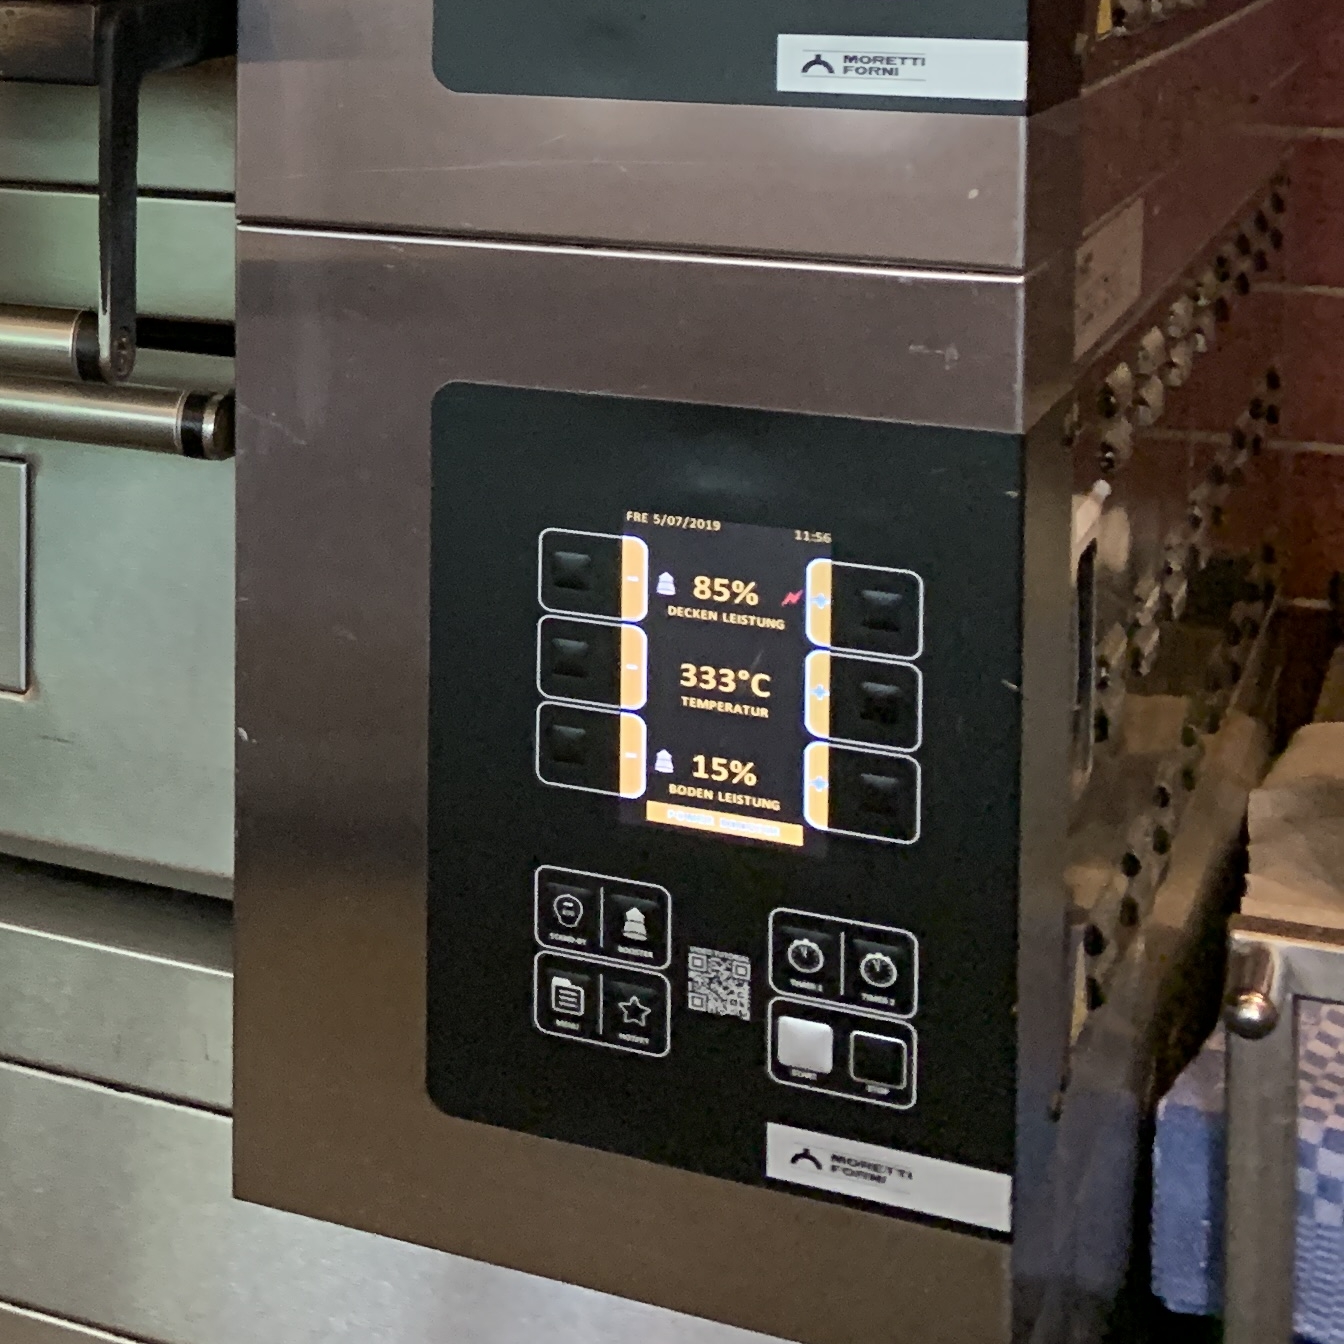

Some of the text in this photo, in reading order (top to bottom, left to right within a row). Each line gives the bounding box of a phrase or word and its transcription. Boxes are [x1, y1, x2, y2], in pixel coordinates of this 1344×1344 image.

[842, 66, 899, 77] FORNI
[843, 55, 926, 67] MORETTI
[626, 511, 832, 544] FRE 5/07/2019 11:56
[692, 575, 759, 606] 85%
[667, 605, 785, 631] DECKEN LEISTUNG
[679, 663, 772, 698] 333°C
[681, 696, 769, 718] TEMPERATUR
[692, 754, 757, 787] 15%
[669, 783, 781, 812] BODEN LEISTUNG
